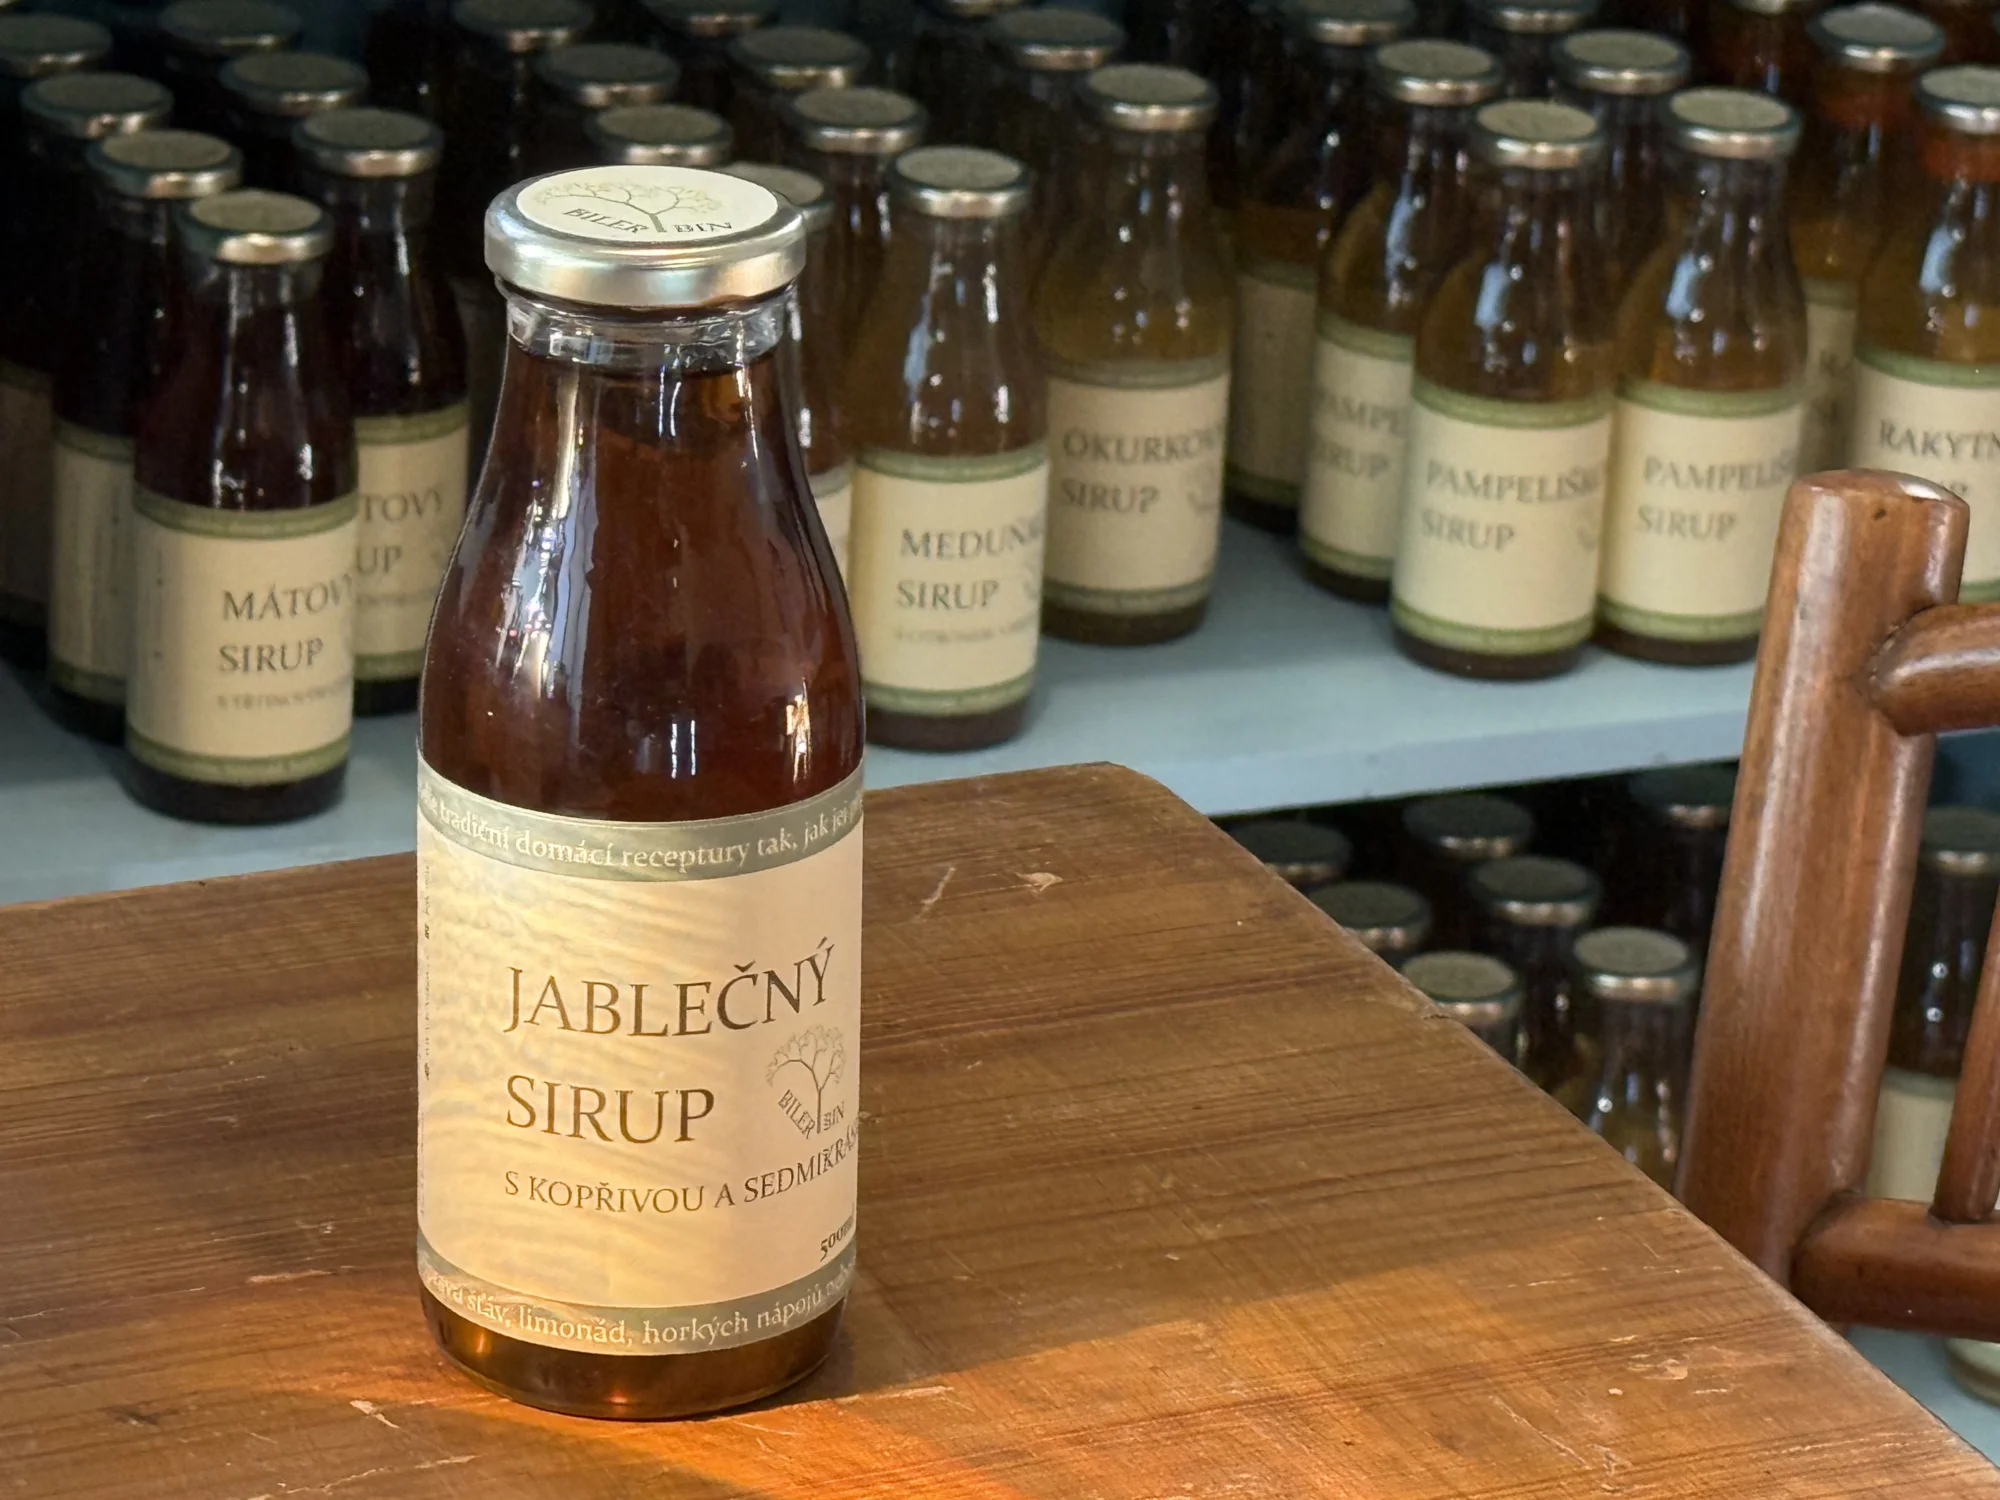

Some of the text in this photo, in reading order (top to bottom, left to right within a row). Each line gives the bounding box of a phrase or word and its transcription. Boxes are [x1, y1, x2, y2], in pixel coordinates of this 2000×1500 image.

[562, 208, 732, 235] BILER BIN
[1060, 477, 1160, 514] SIRUP
[1420, 508, 1515, 552] SIRUP
[1637, 504, 1738, 541] SIRUP
[897, 578, 1000, 611] SIRUP
[217, 636, 325, 674] SIRUP
[515, 829, 615, 868] domácí
[620, 841, 750, 874] receptury
[801, 811, 830, 854] jak
[502, 935, 836, 1038] JABLEČNÝ
[505, 1073, 715, 1145] SIRUP
[777, 1088, 846, 1141] BILER BIN
[504, 1171, 520, 1197] S
[528, 1177, 704, 1214] KOPŘIVOU
[713, 1183, 736, 1210] A
[519, 1303, 634, 1347] limonád,
[643, 1311, 750, 1346] horkých
[756, 1282, 822, 1329] nápojů
